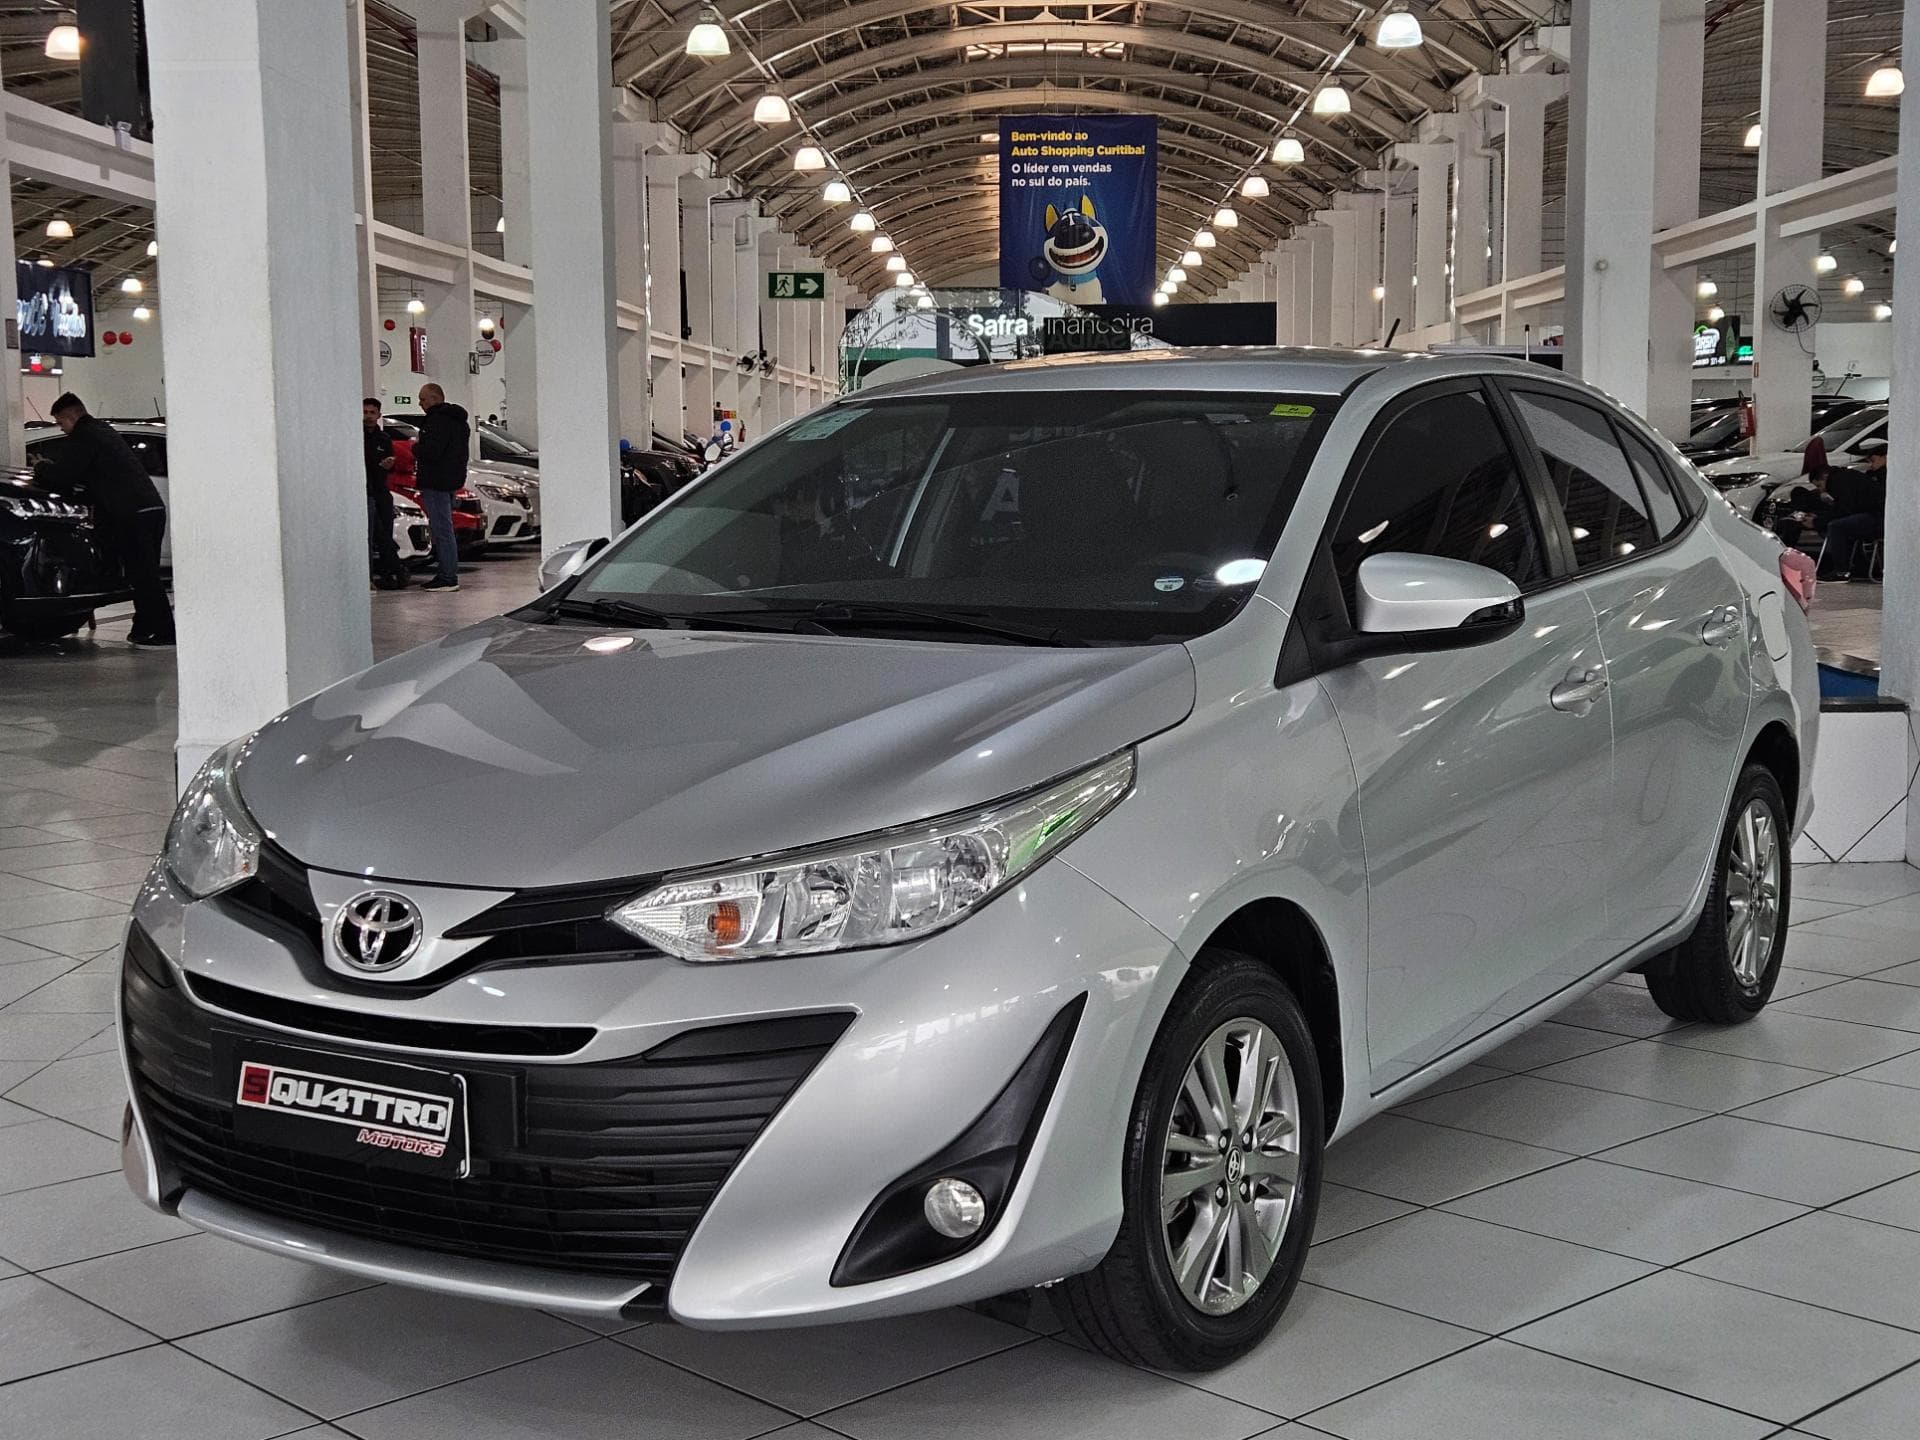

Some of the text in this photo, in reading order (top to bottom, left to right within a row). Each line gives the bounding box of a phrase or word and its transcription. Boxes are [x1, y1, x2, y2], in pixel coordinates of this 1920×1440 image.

[1011, 131, 1089, 141] Bem-vindo ao
[1011, 145, 1146, 158] Auto Shopping Curitiba!
[1011, 163, 1112, 174] O líder em vendas
[1011, 176, 1092, 188] no sul do país.
[968, 312, 1154, 336] Safra inanceira
[356, 1129, 446, 1158] MOTORS
